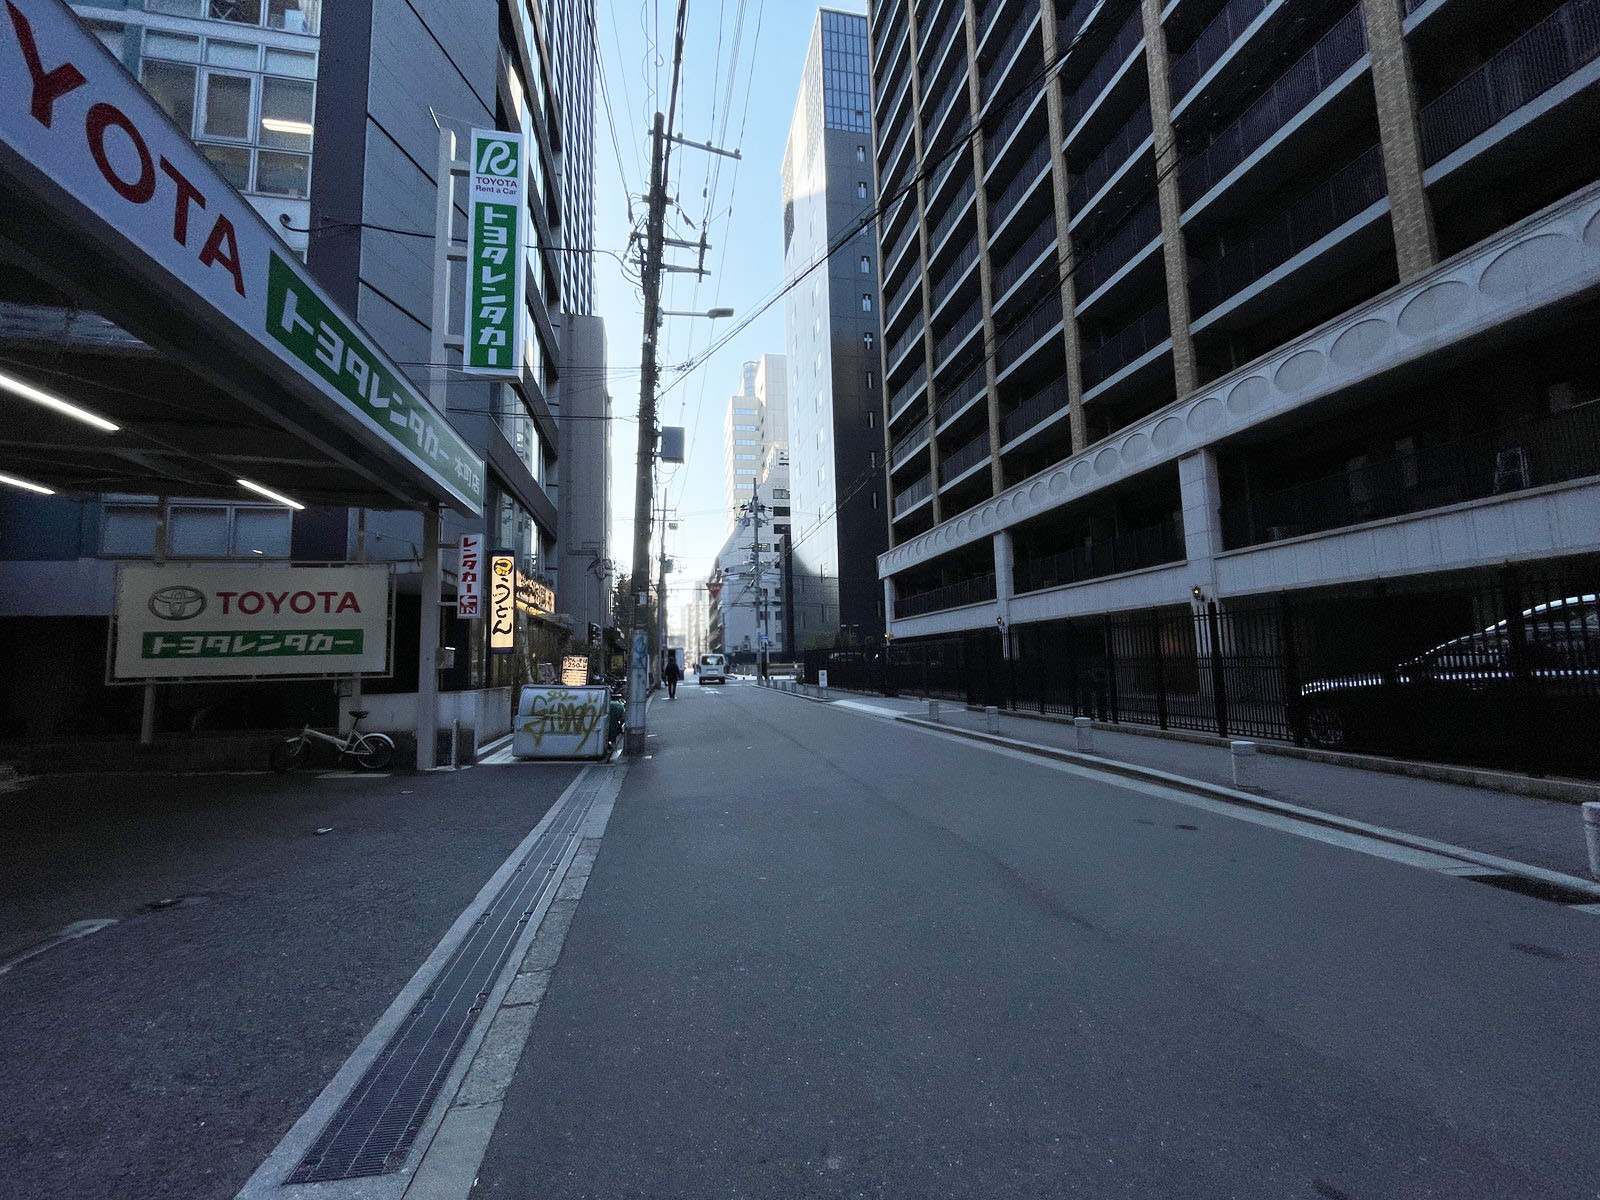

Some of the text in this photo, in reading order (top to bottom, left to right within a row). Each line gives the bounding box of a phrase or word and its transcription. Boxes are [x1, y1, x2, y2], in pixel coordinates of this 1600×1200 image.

[5, 0, 247, 300] YOTA
[476, 176, 517, 188] TOYOTA
[476, 185, 494, 193] Rent
[502, 187, 517, 195] Car
[478, 206, 508, 366] トヨタレンタカー
[281, 287, 481, 495] トヨタレンタカー 本町店
[461, 537, 477, 593] レンタカー
[216, 590, 362, 615] TOYOTA
[460, 606, 476, 614] IN
[492, 577, 514, 636] うどん
[150, 632, 354, 655] トヨタレンタカー
